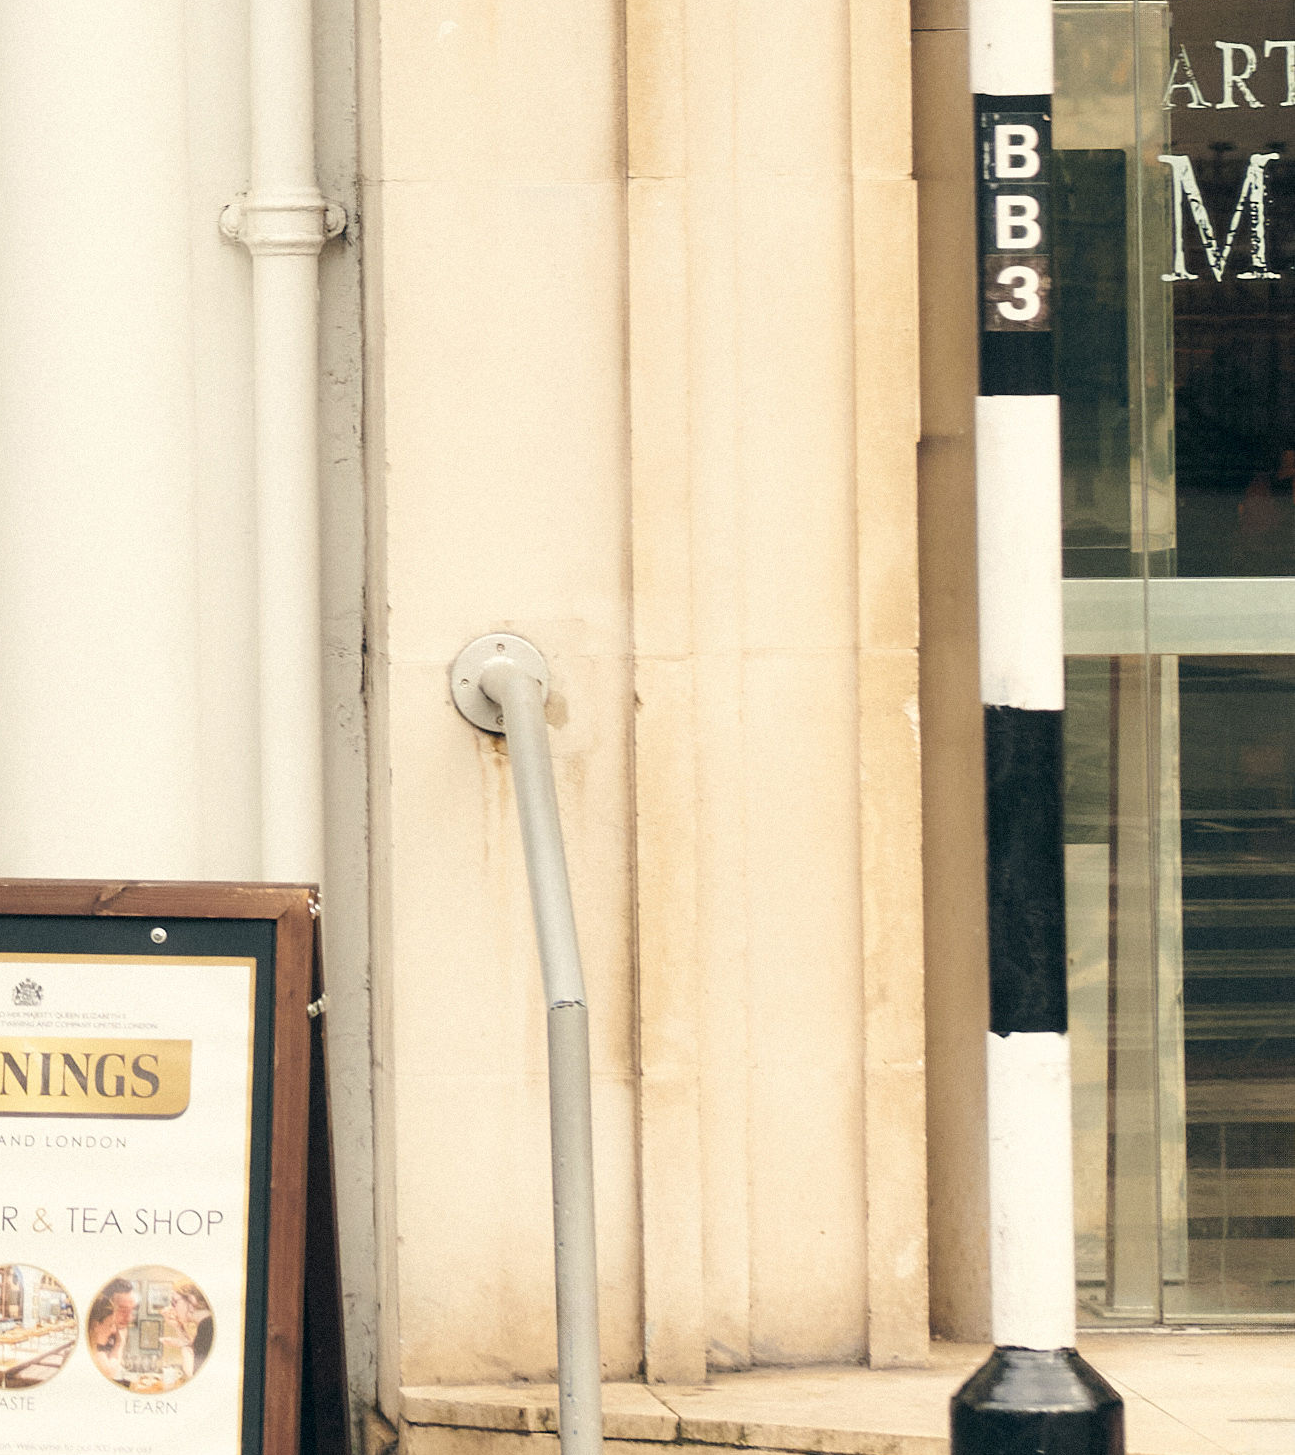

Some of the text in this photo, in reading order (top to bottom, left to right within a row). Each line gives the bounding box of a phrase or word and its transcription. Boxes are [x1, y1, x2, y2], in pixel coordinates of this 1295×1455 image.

[45, 1134, 128, 1149] LONDON
[31, 1207, 54, 1233] &
[67, 1207, 123, 1234] TEA
[134, 1208, 225, 1236] SHOP
[124, 1399, 178, 1415] LEARN
